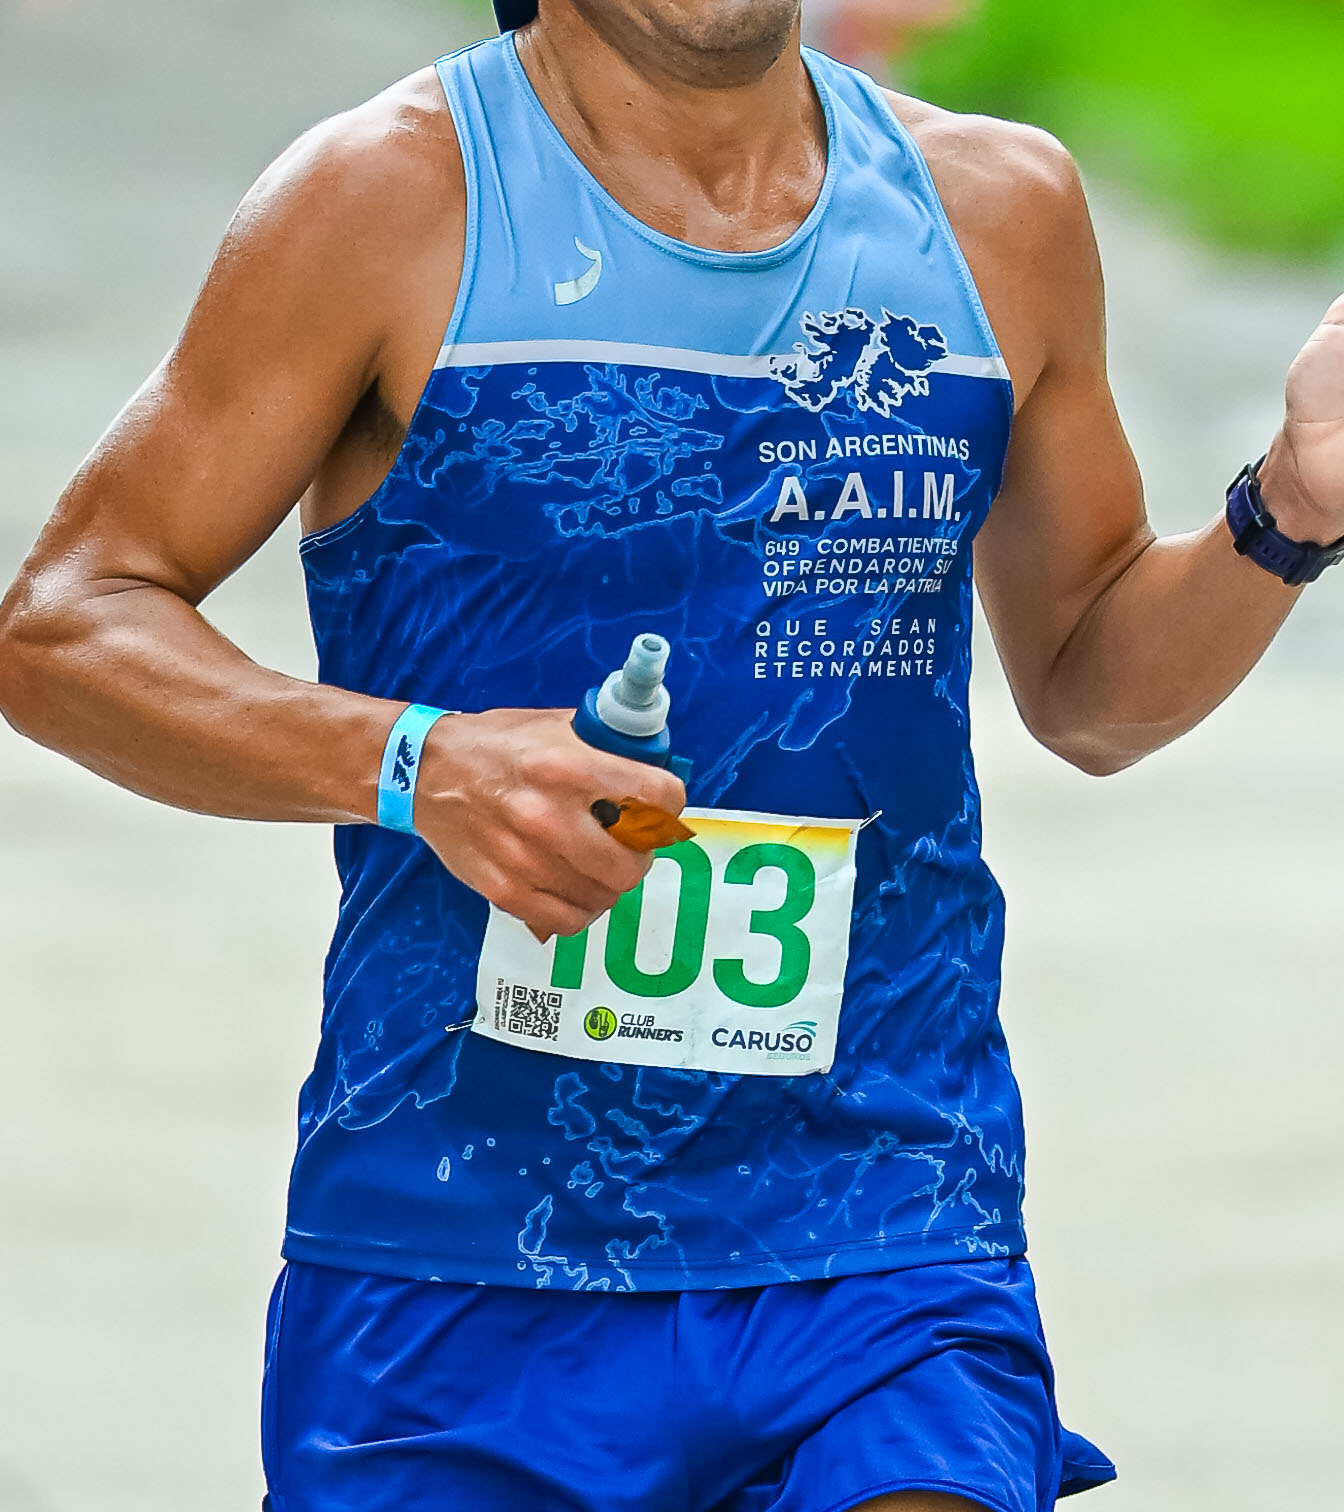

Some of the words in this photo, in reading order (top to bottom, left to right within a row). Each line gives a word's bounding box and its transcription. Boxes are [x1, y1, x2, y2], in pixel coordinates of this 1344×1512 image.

[758, 439, 817, 463] SON
[825, 434, 970, 461] ARGENTINAS
[769, 469, 961, 522] A.A.I.M.
[764, 540, 800, 556] 649
[816, 537, 958, 556] COMBATIENTES
[763, 558, 925, 576] OFRENDARON
[933, 559, 954, 575] SU
[762, 579, 808, 597] VIDA
[815, 578, 857, 594] POR
[863, 578, 889, 594] LA
[893, 578, 943, 594] PATRIA
[756, 619, 828, 637] QUE
[870, 618, 937, 636] SEAN
[755, 639, 936, 658] RECORDADOS
[754, 659, 934, 679] ETERNAMENTE
[620, 1013, 656, 1027] CLUB
[617, 1025, 685, 1042] RUNNER'S
[711, 1028, 813, 1053] CARUSO
